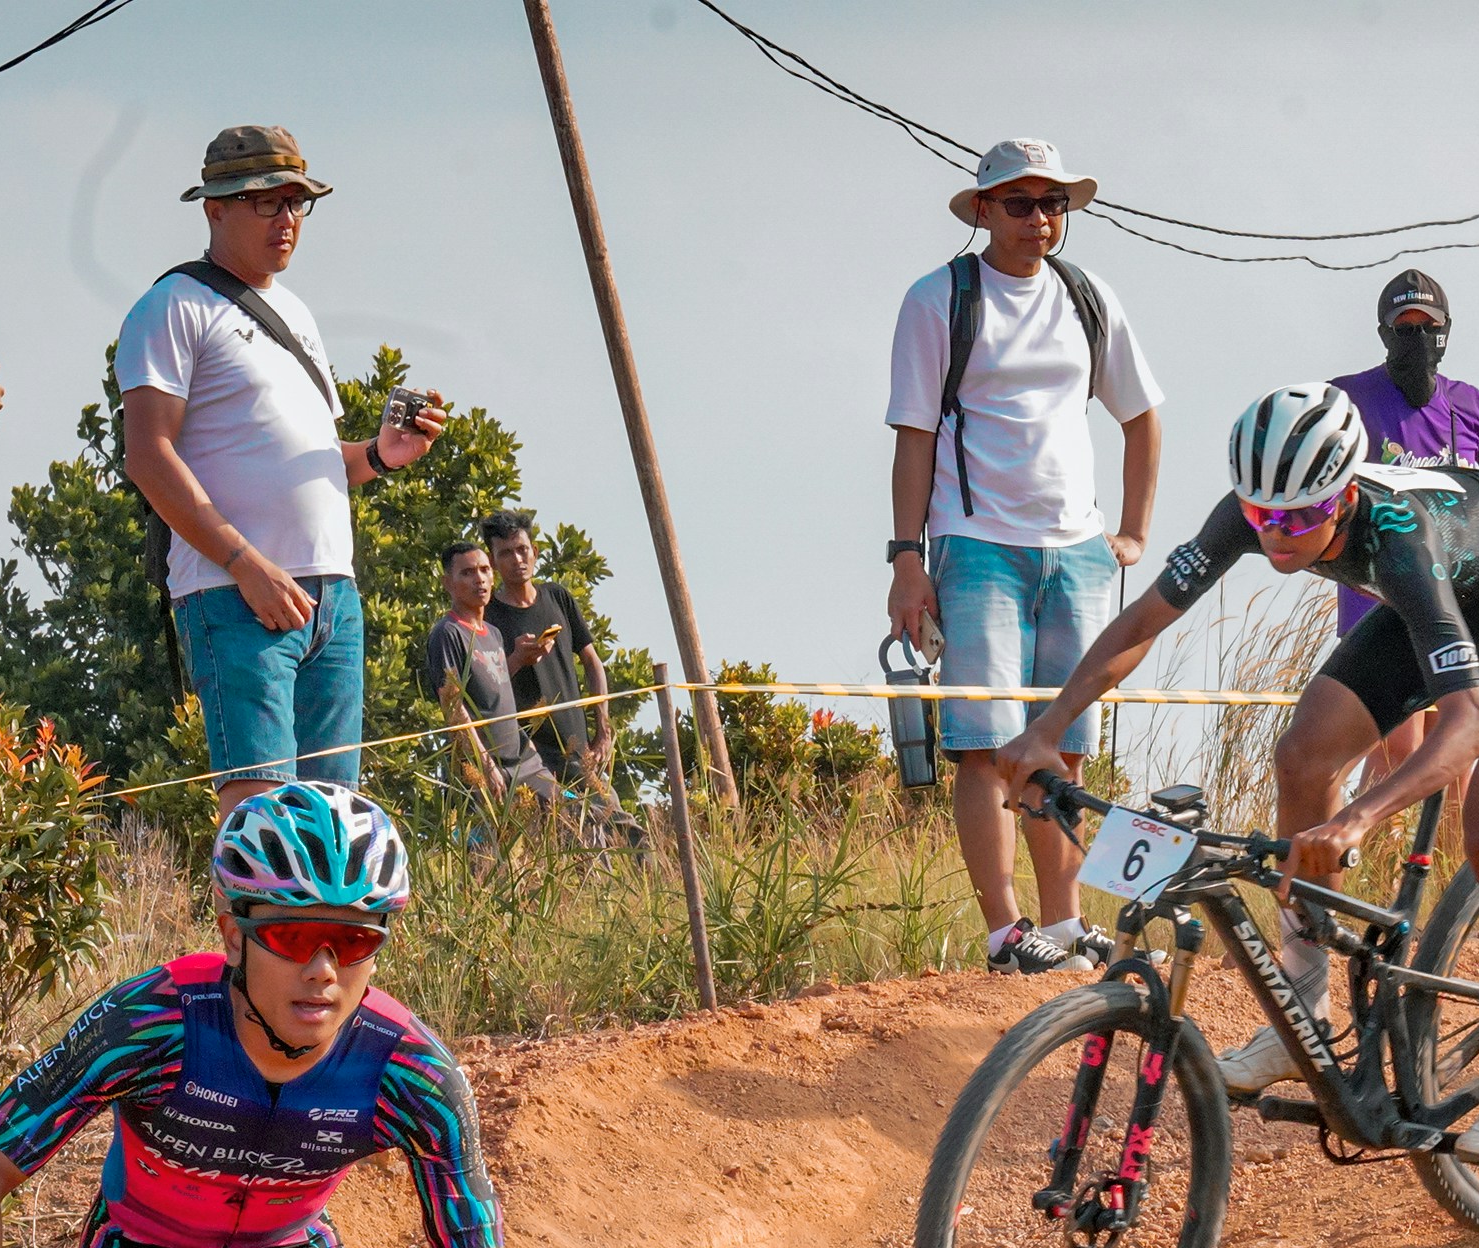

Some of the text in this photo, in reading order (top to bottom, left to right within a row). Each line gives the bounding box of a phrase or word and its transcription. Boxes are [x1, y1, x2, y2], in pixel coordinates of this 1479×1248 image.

[1392, 291, 1434, 304] NEW ZEALAND
[1131, 818, 1168, 837] OCBC
[1123, 839, 1151, 882] 6
[1232, 920, 1335, 1073] SANTA CRUZ
[16, 1042, 66, 1092] ALPEN
[67, 995, 117, 1041] BLICK
[1081, 1032, 1107, 1067] 3
[1141, 1051, 1164, 1085] 4
[196, 1087, 238, 1108] HOKUEI
[322, 1109, 359, 1117] PRO
[176, 1115, 236, 1133] HONDA
[141, 1121, 207, 1158] ALPEN
[212, 1147, 274, 1165] BLICK
[1119, 1124, 1155, 1182] FOX
[143, 1145, 222, 1180] ASIA
